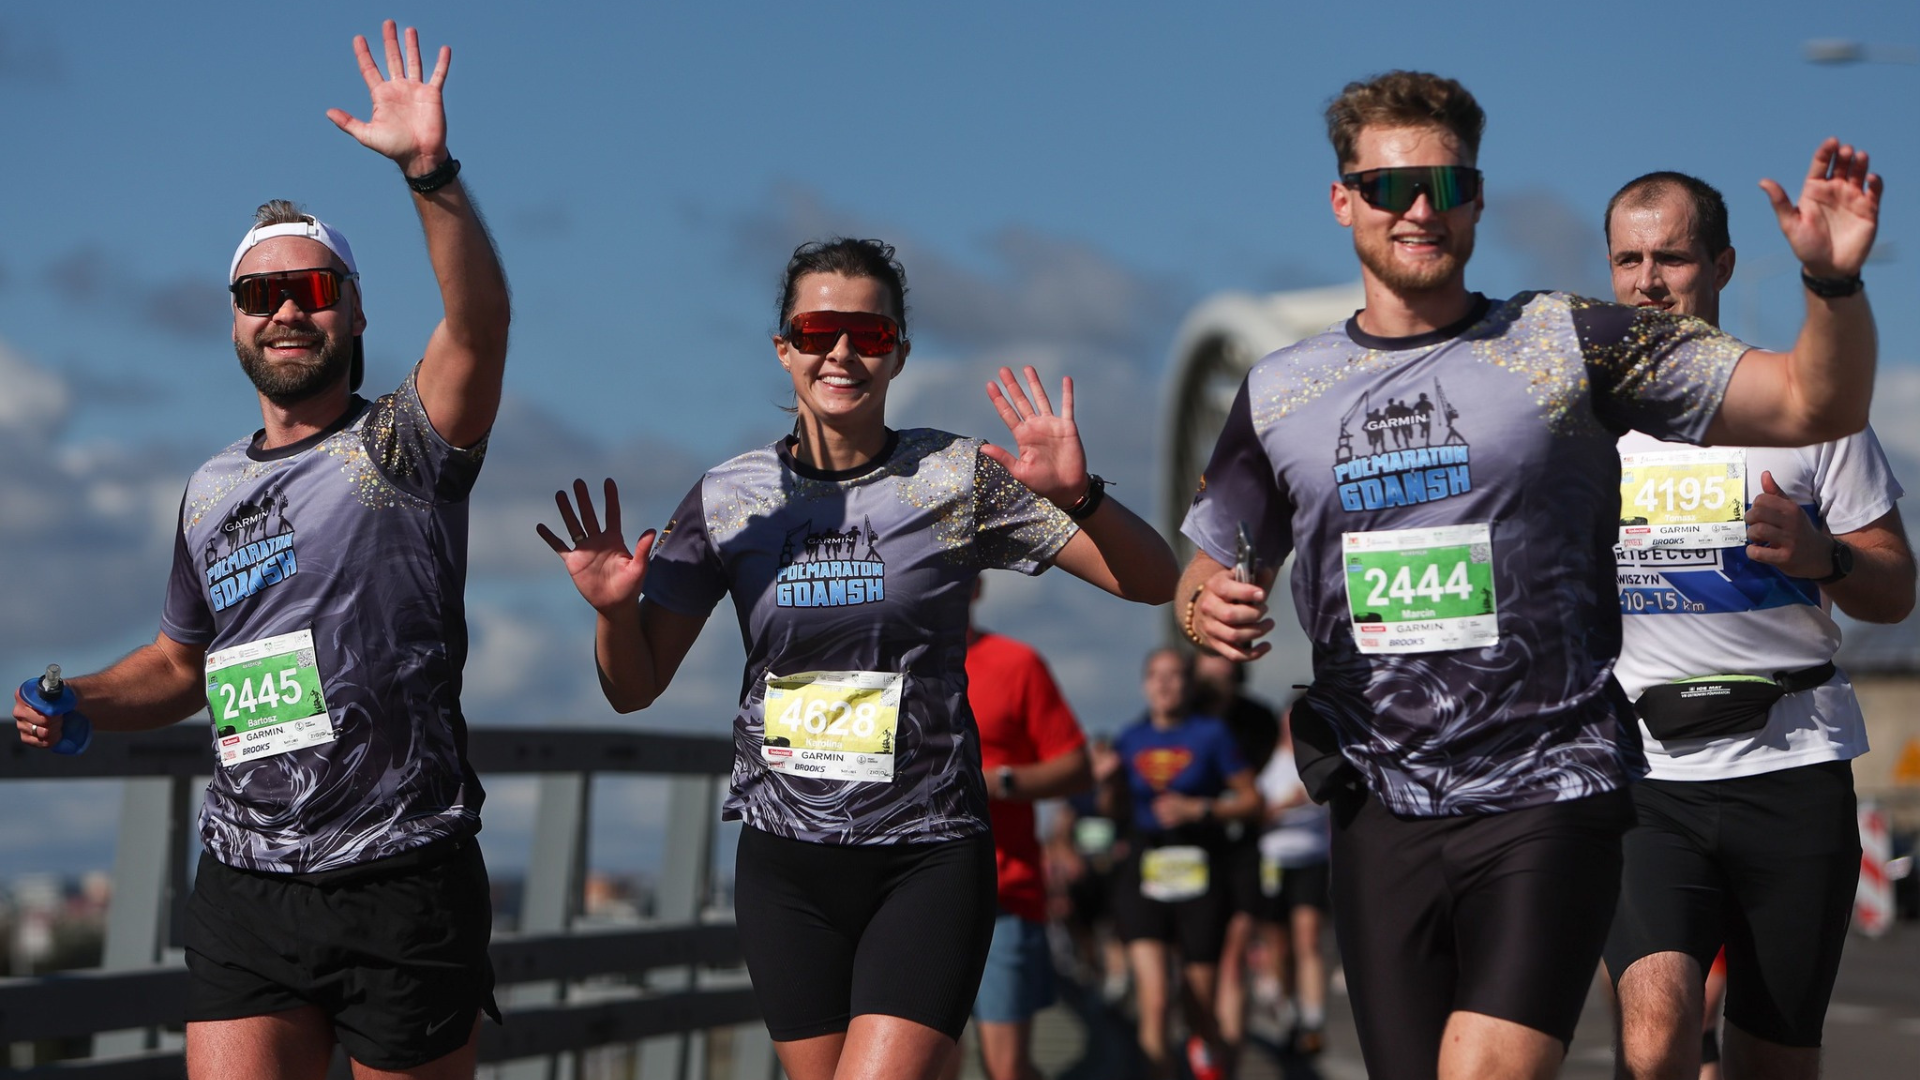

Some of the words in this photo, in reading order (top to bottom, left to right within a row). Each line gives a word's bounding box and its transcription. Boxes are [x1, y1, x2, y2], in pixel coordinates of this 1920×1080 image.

[1367, 414, 1428, 431] GARMIN
[1333, 445, 1469, 483] PÓŁMARATON
[1634, 475, 1726, 512] 4195
[225, 510, 269, 532] GARMIN
[1665, 514, 1697, 522] Tomasz
[1660, 526, 1700, 535] GARMIN
[807, 536, 855, 545] GARMIN
[1652, 537, 1685, 546] BROOKS
[206, 532, 295, 585] PÓŁMARATON
[777, 561, 884, 582] PÓŁMARATON
[1364, 561, 1473, 607] 2444
[1615, 574, 1660, 585] WISZYN
[1682, 600, 1705, 612] km
[1401, 608, 1436, 619] Marcin
[1396, 623, 1444, 633] GARMIN
[1389, 638, 1425, 647] BROOKS
[220, 667, 302, 720] 2445
[247, 715, 278, 728] Bartosz
[779, 697, 876, 738] 4628
[246, 727, 284, 742] GARMIN
[242, 743, 270, 756] BROOKS
[805, 738, 843, 750] Karolina
[801, 751, 844, 762] GARMIN
[794, 763, 826, 773] BROOKS
